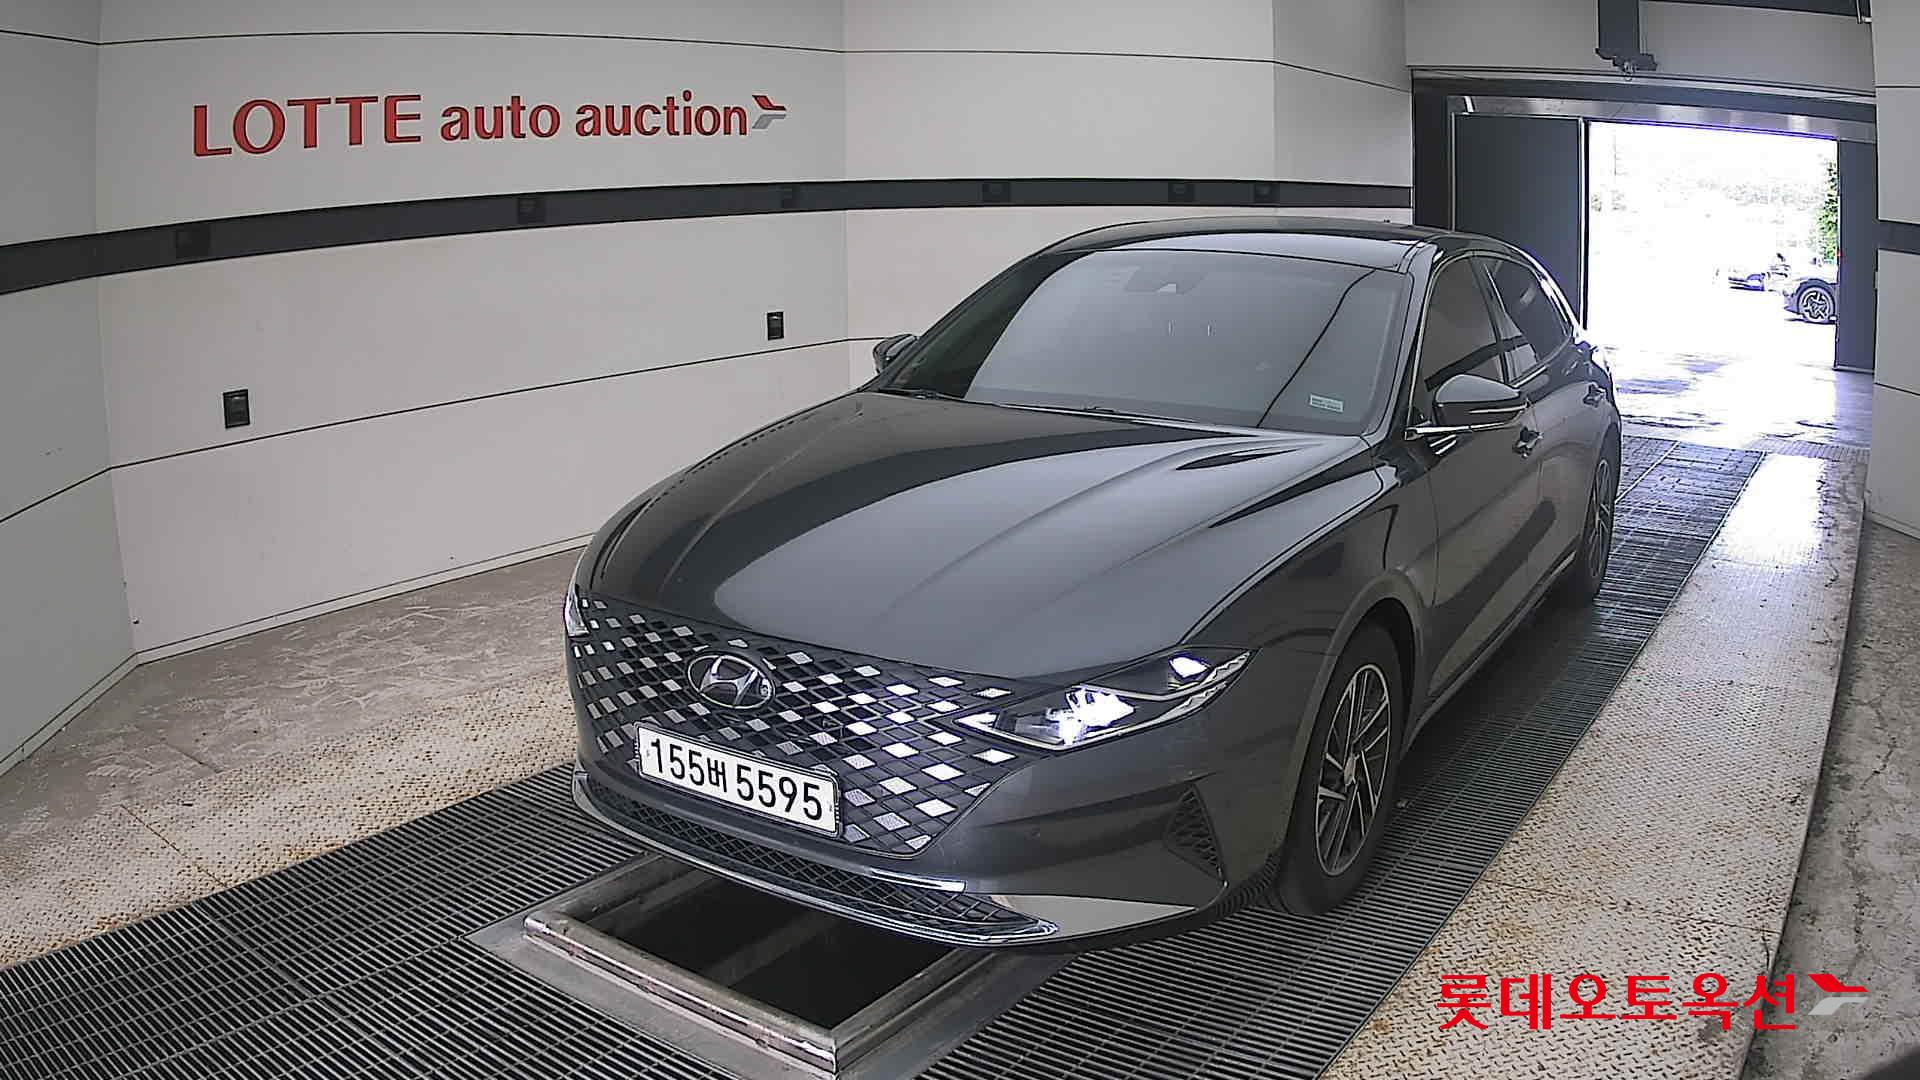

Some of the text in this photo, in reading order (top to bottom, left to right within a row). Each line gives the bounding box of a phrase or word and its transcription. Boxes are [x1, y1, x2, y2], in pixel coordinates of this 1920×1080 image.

[193, 90, 748, 157] LOTTE auto auction
[651, 738, 823, 821] 155버 5595
